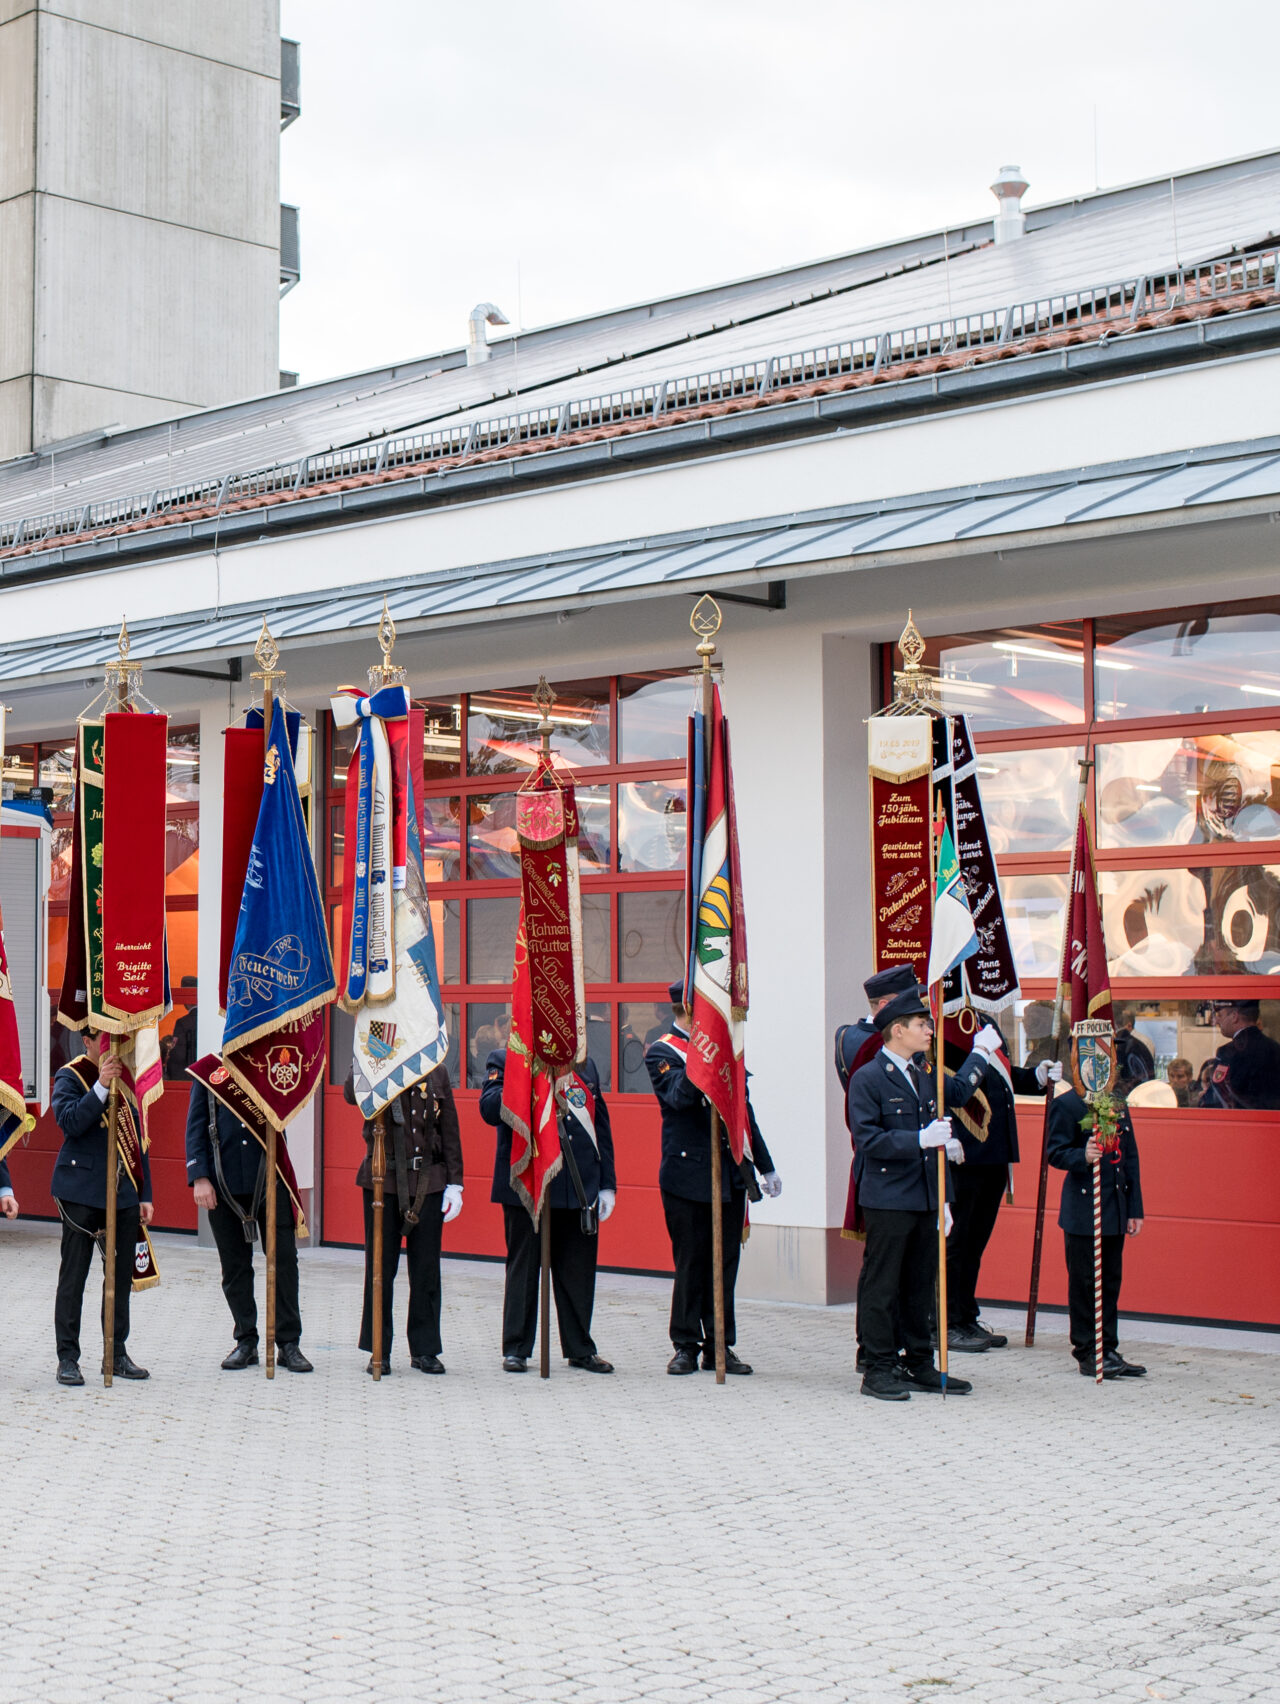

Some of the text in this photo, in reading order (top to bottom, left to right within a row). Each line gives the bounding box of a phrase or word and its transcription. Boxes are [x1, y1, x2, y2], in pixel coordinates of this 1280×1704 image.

[889, 793, 912, 802] Zum
[877, 815, 923, 827] Jubiläum
[881, 841, 923, 852] gewidmet
[959, 840, 982, 851] idmet
[900, 851, 922, 859] eurer
[522, 854, 556, 900] Gewidmet
[880, 878, 928, 922] Patenbraut
[354, 915, 366, 938] 100
[527, 913, 570, 937] Fahnen
[369, 892, 388, 974] Stadtgemeinde
[528, 939, 570, 953] Mutter
[887, 939, 922, 948] Sabrina
[881, 949, 927, 961] Danninger
[116, 961, 152, 972] Brigitte
[977, 960, 1000, 970] Anna
[122, 971, 147, 981] Seil
[237, 956, 300, 988] Feuerwehr
[542, 955, 572, 998] Gusti
[533, 976, 575, 1041] Riermeier
[1076, 1023, 1112, 1034] FF POCKING
[690, 1021, 720, 1064] ing
[241, 1097, 267, 1125] Indling
